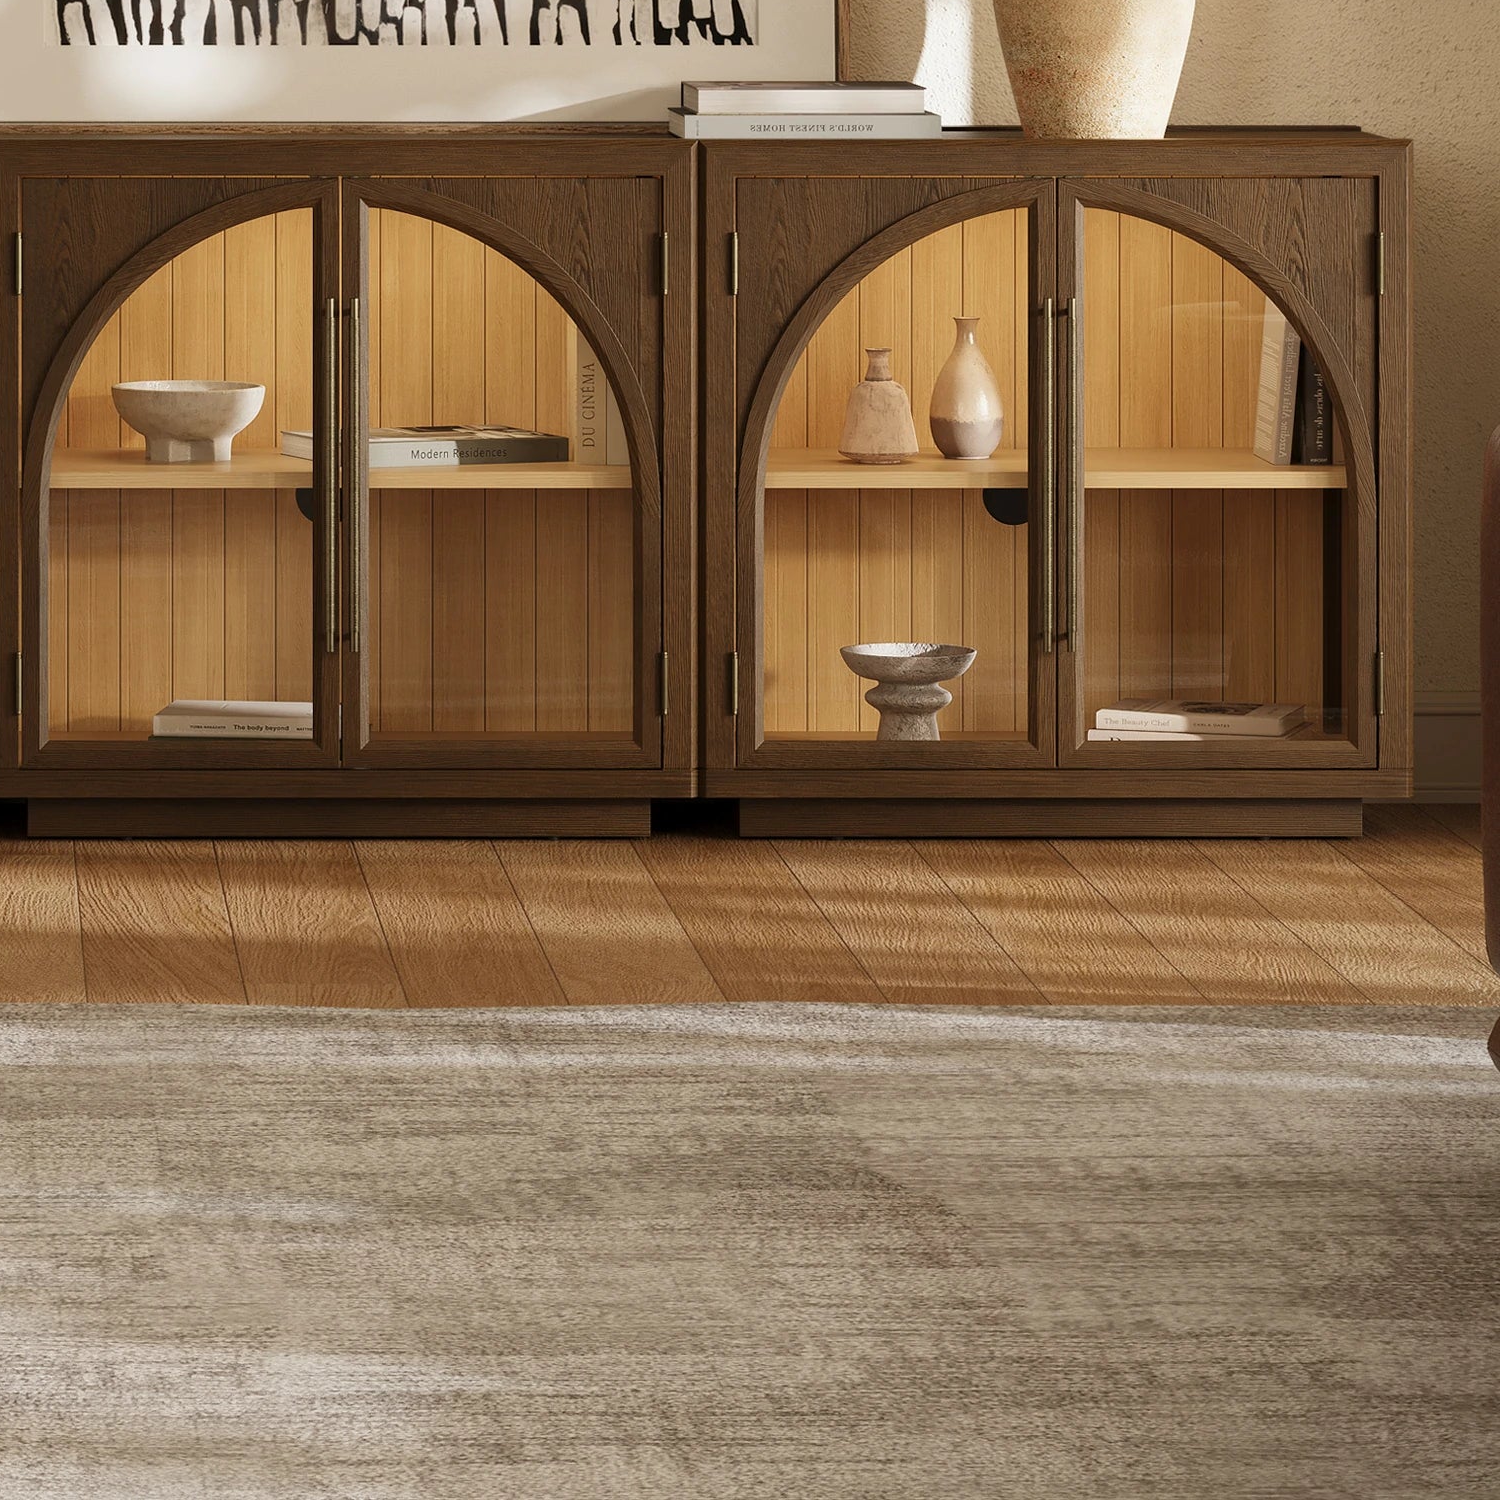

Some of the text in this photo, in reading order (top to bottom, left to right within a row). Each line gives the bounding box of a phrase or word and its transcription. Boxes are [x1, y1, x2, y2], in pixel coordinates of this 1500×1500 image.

[581, 362, 596, 448] DU CINÉMA
[411, 448, 508, 460] Modern Residences
[233, 723, 246, 731] The
[247, 724, 264, 732] body
[1104, 717, 1170, 727] The Beauty Chef
